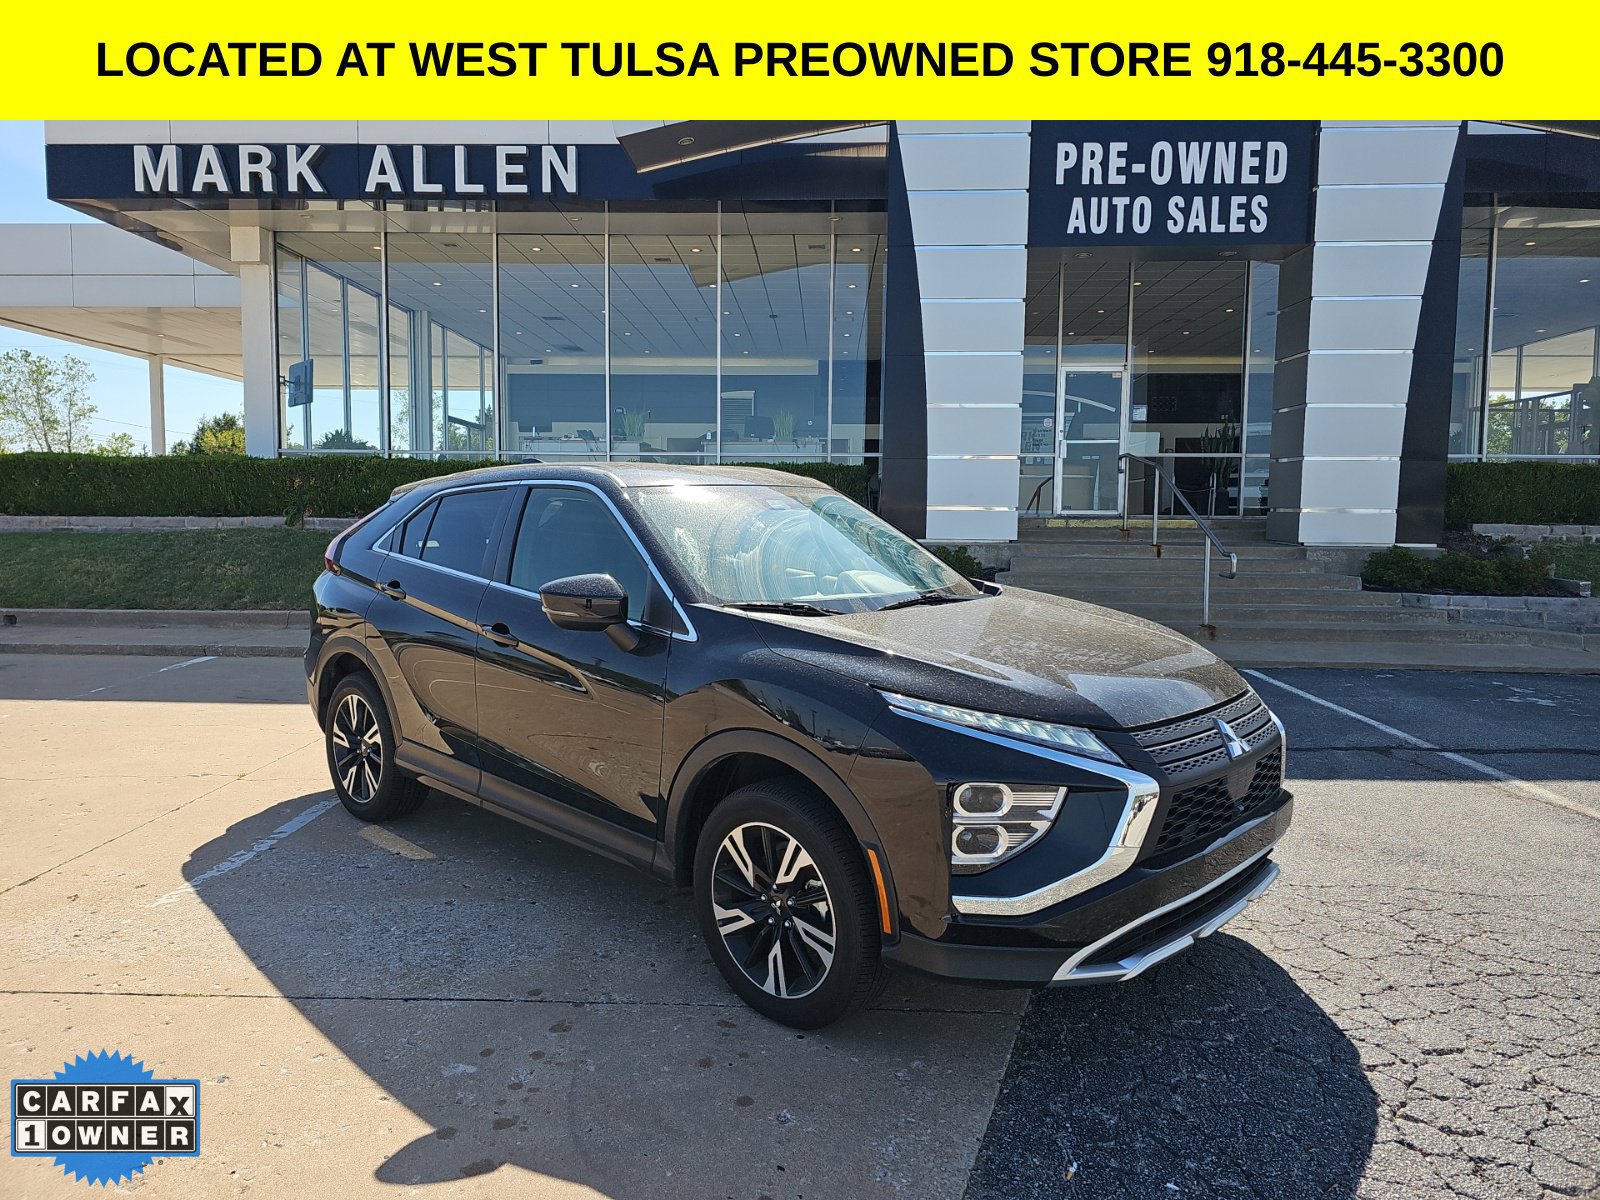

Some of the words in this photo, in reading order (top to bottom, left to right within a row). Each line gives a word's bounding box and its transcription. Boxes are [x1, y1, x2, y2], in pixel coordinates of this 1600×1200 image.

[133, 144, 326, 193] MARK
[364, 144, 579, 194] ALLEN
[1055, 141, 1289, 186] PRE-OWNED
[1066, 195, 1152, 235] AUTO
[1166, 194, 1269, 234] SALES
